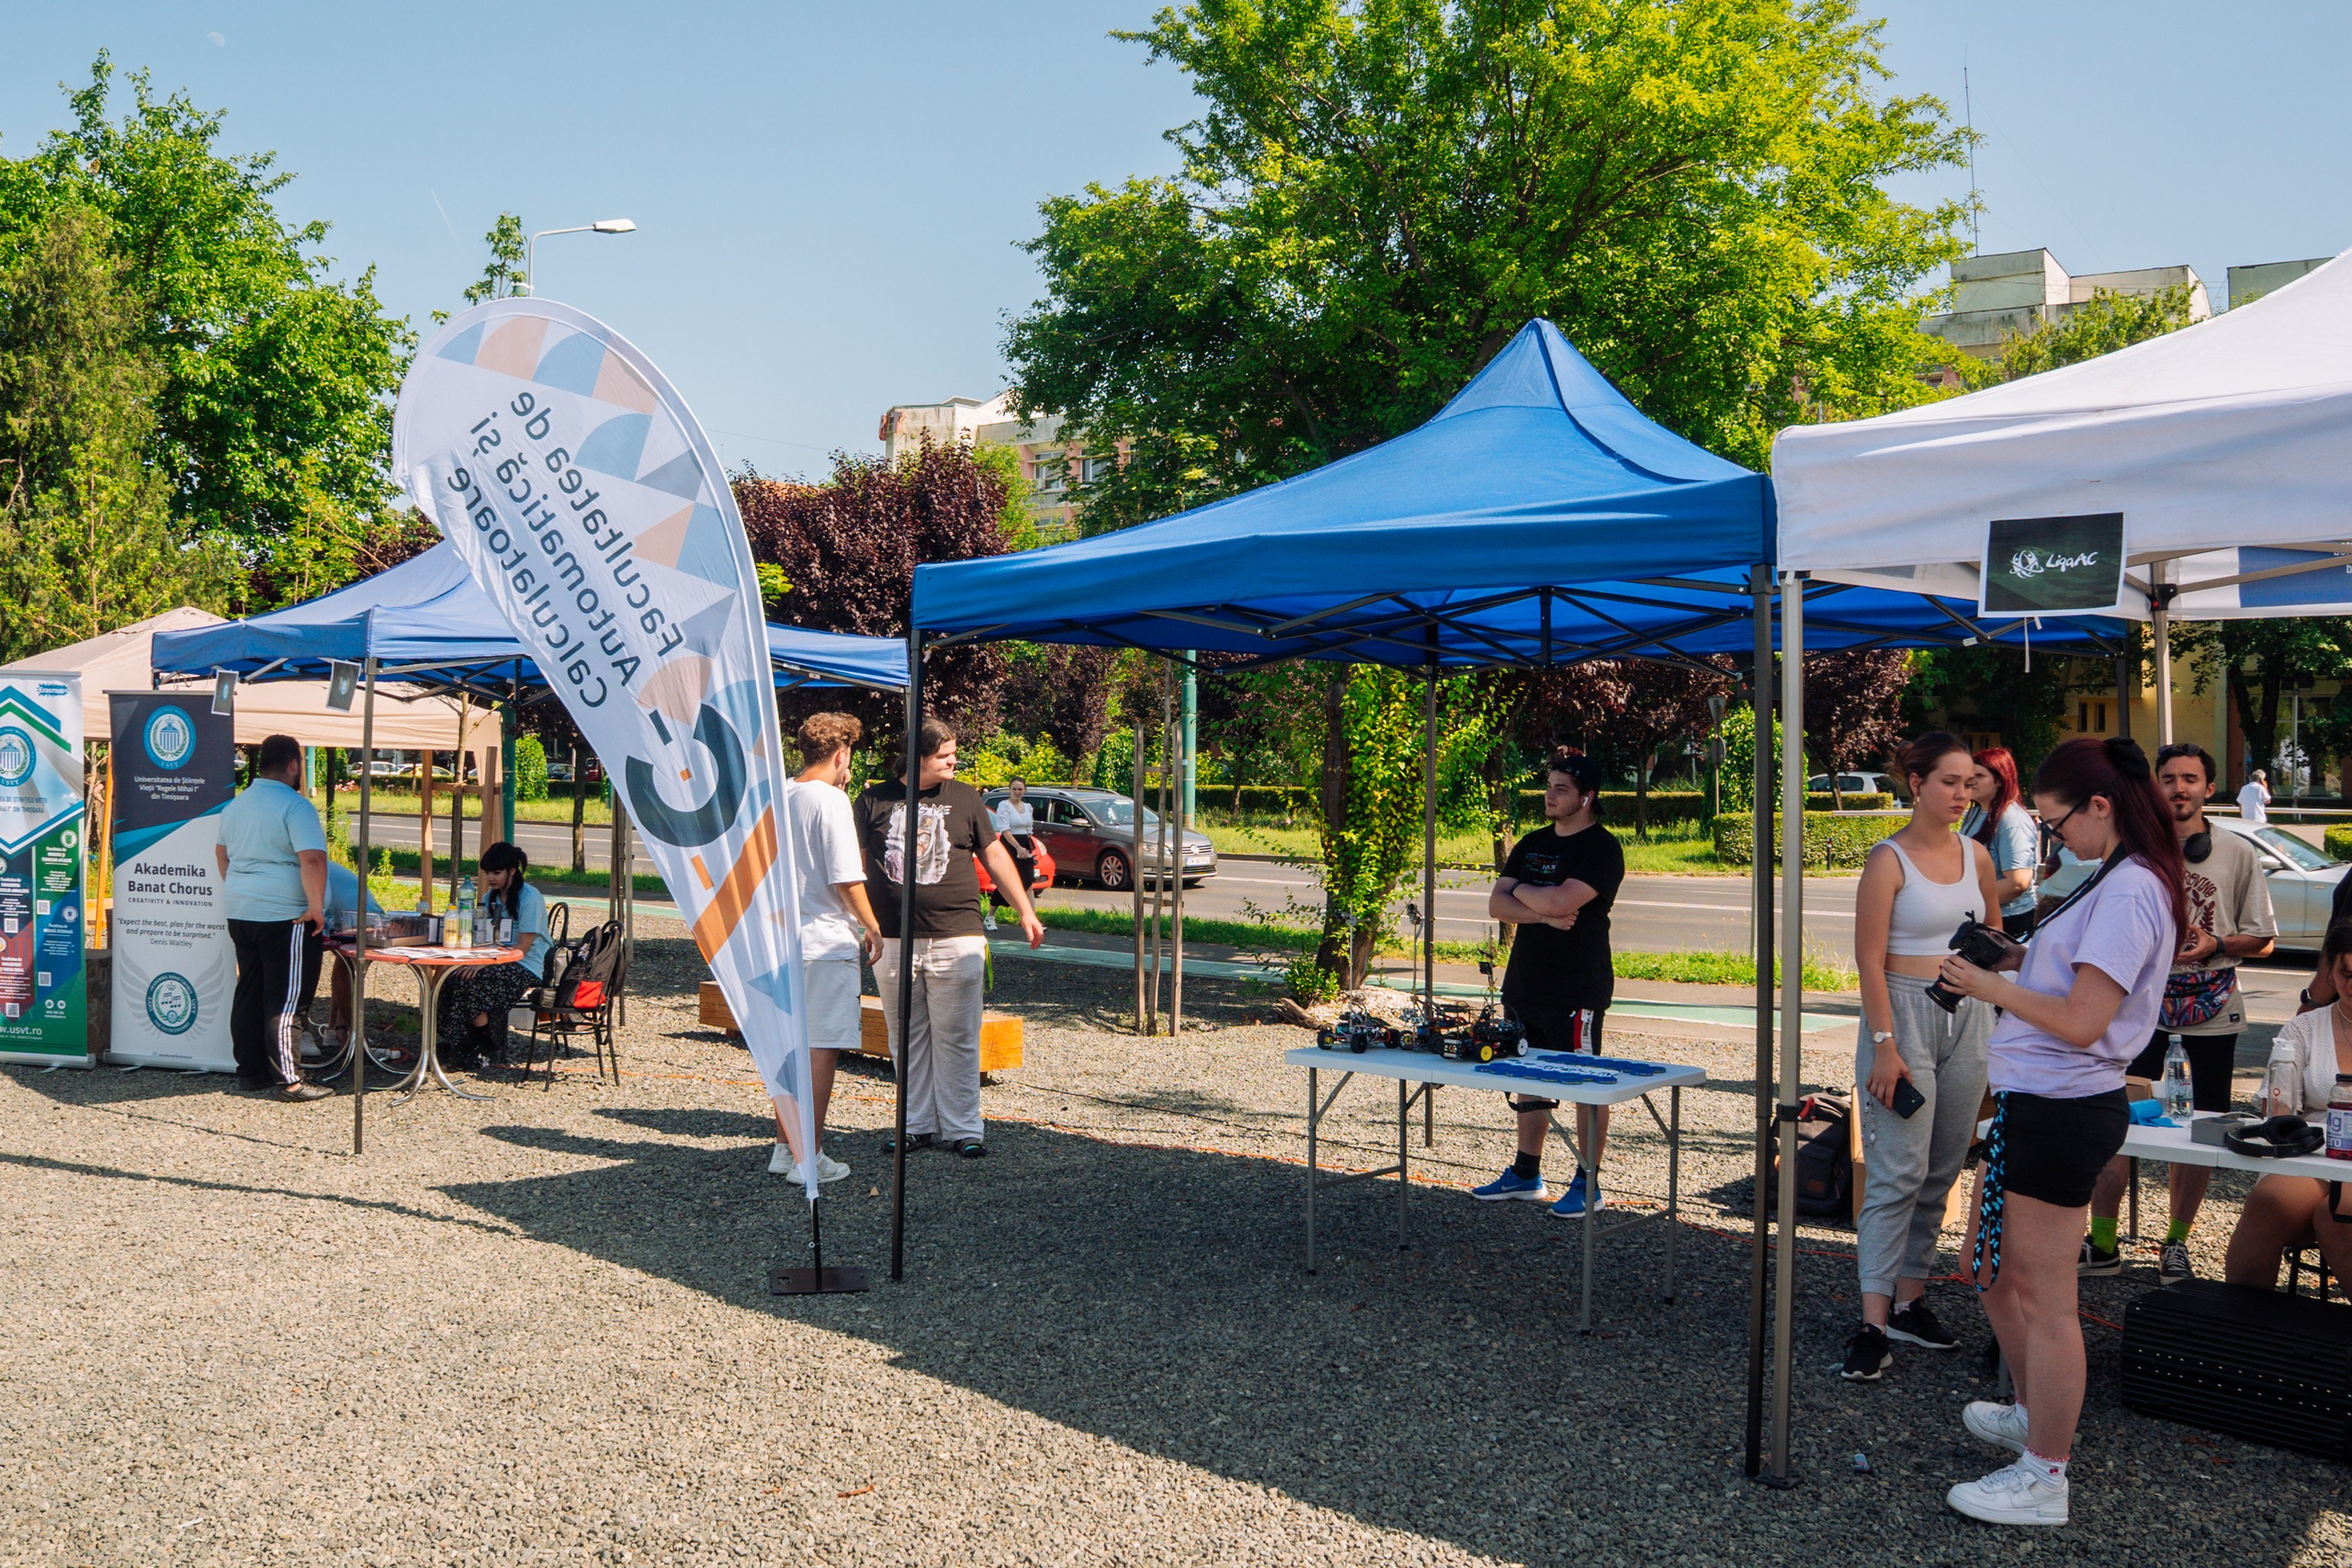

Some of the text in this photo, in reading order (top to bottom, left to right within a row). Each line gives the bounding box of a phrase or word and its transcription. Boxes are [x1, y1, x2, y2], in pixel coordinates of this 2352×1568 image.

[134, 863, 207, 877] Akademika
[128, 881, 213, 896] Banat Chorus
[169, 920, 184, 929] plan
[184, 921, 194, 930] for
[195, 921, 206, 930] the
[139, 929, 164, 937] prepare
[169, 939, 193, 949] Waitley
